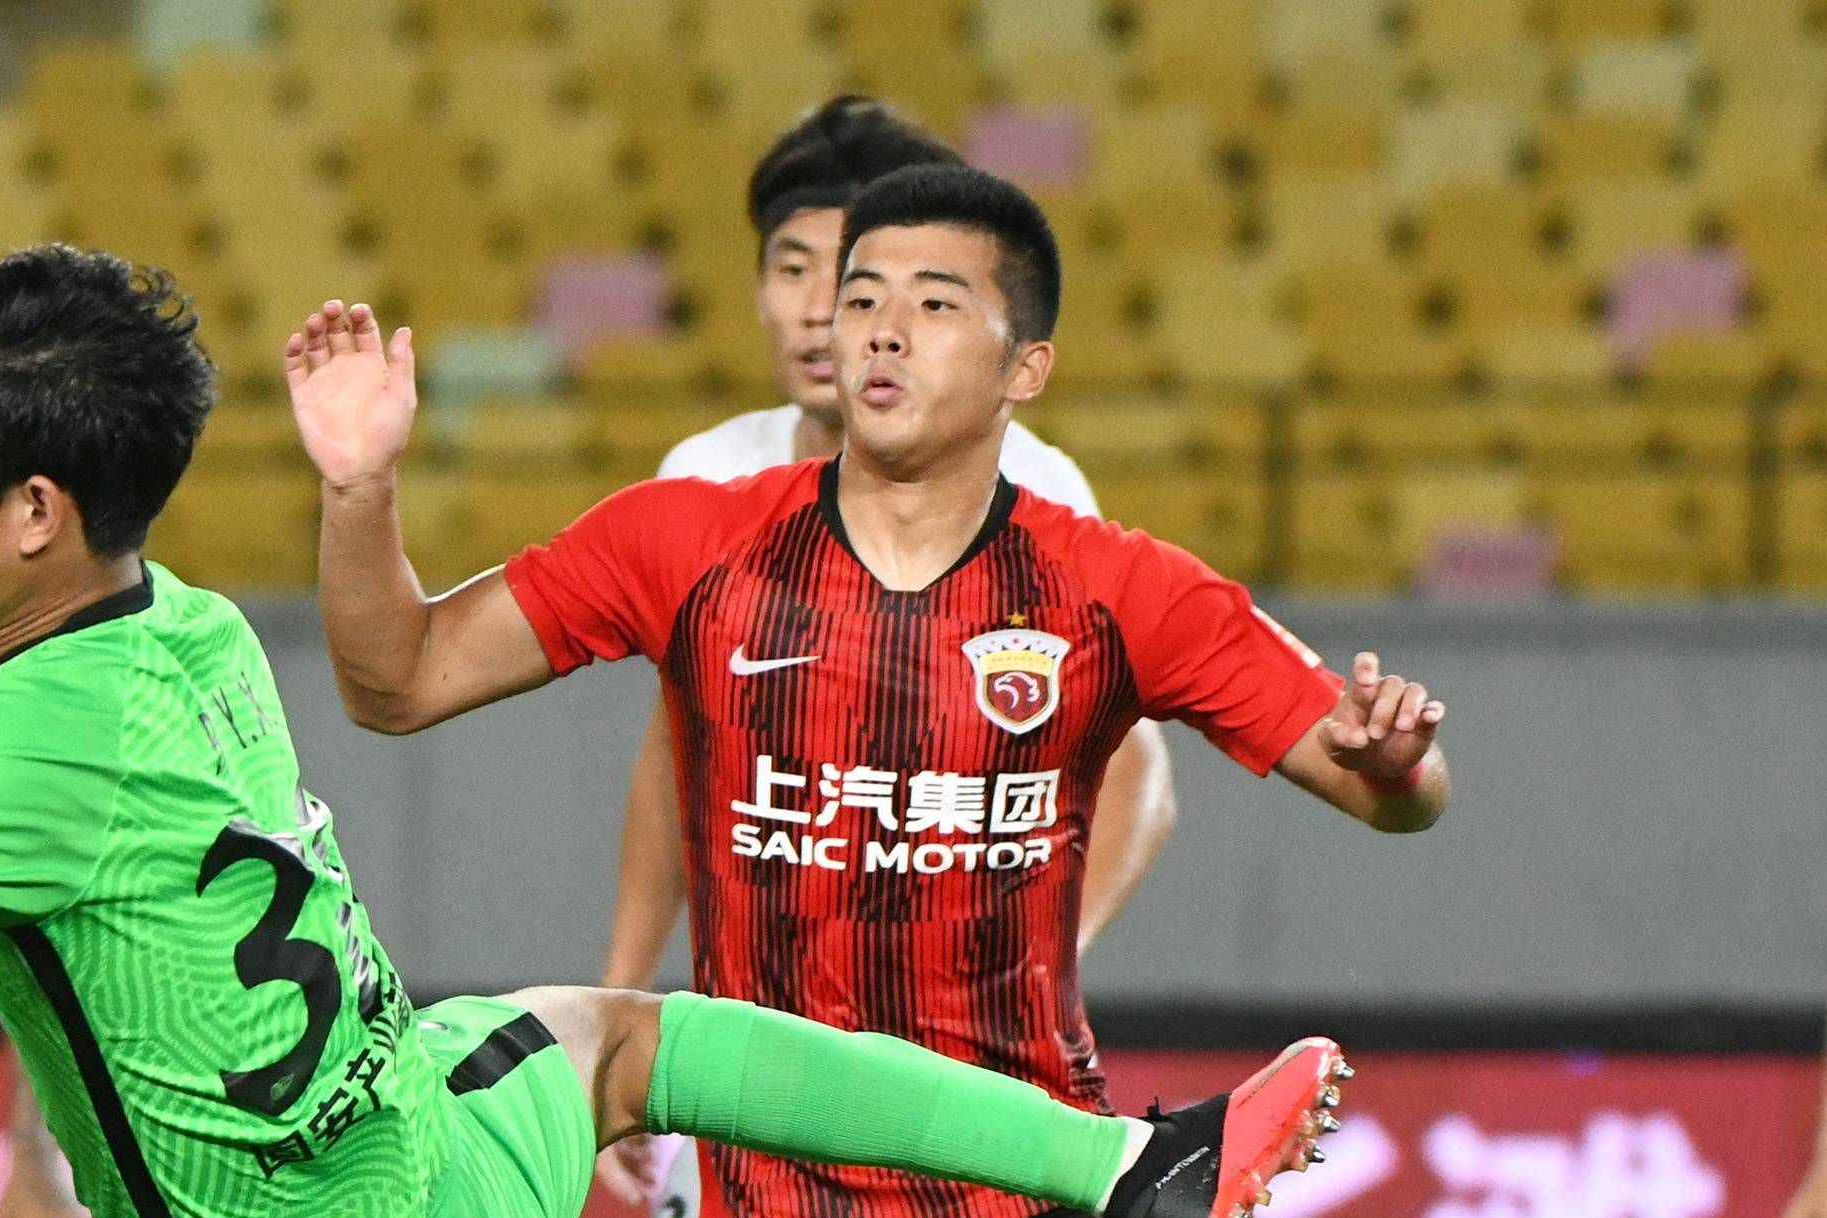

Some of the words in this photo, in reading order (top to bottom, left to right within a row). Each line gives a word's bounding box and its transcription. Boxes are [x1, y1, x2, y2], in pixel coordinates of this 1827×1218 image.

[730, 754, 1062, 835] 上汽集团
[730, 825, 847, 872] SAIC
[864, 837, 1054, 875] MOTOR
